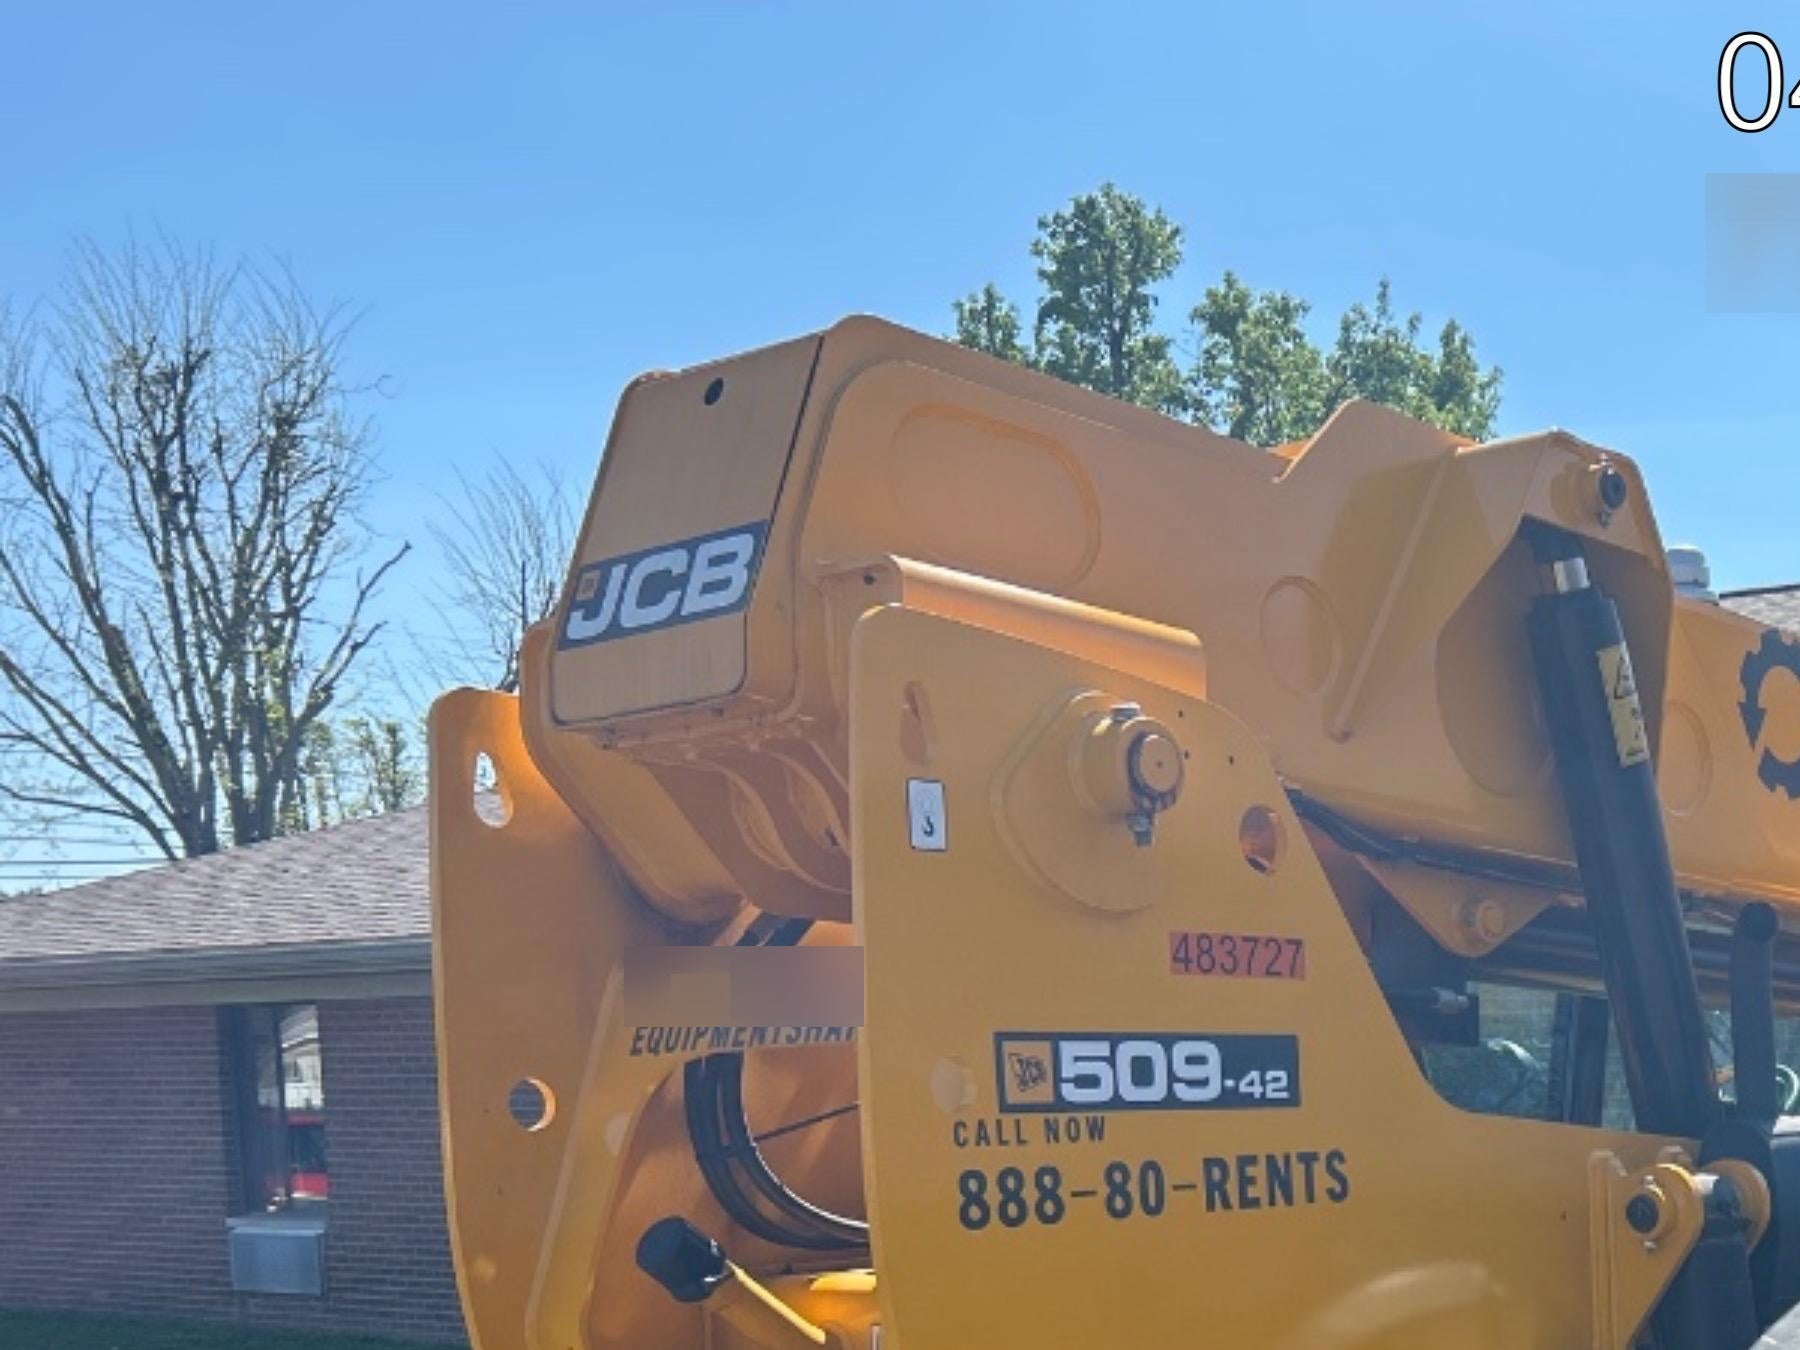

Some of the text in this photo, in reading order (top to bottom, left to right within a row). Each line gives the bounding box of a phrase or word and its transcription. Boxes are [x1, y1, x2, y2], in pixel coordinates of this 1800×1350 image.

[566, 533, 754, 640] JCB
[1172, 932, 1303, 977] 483727
[1058, 1040, 1290, 1103] 509-42
[953, 1116, 1106, 1147] CALL NOW
[958, 1148, 1350, 1231] 888-80-RENTS
